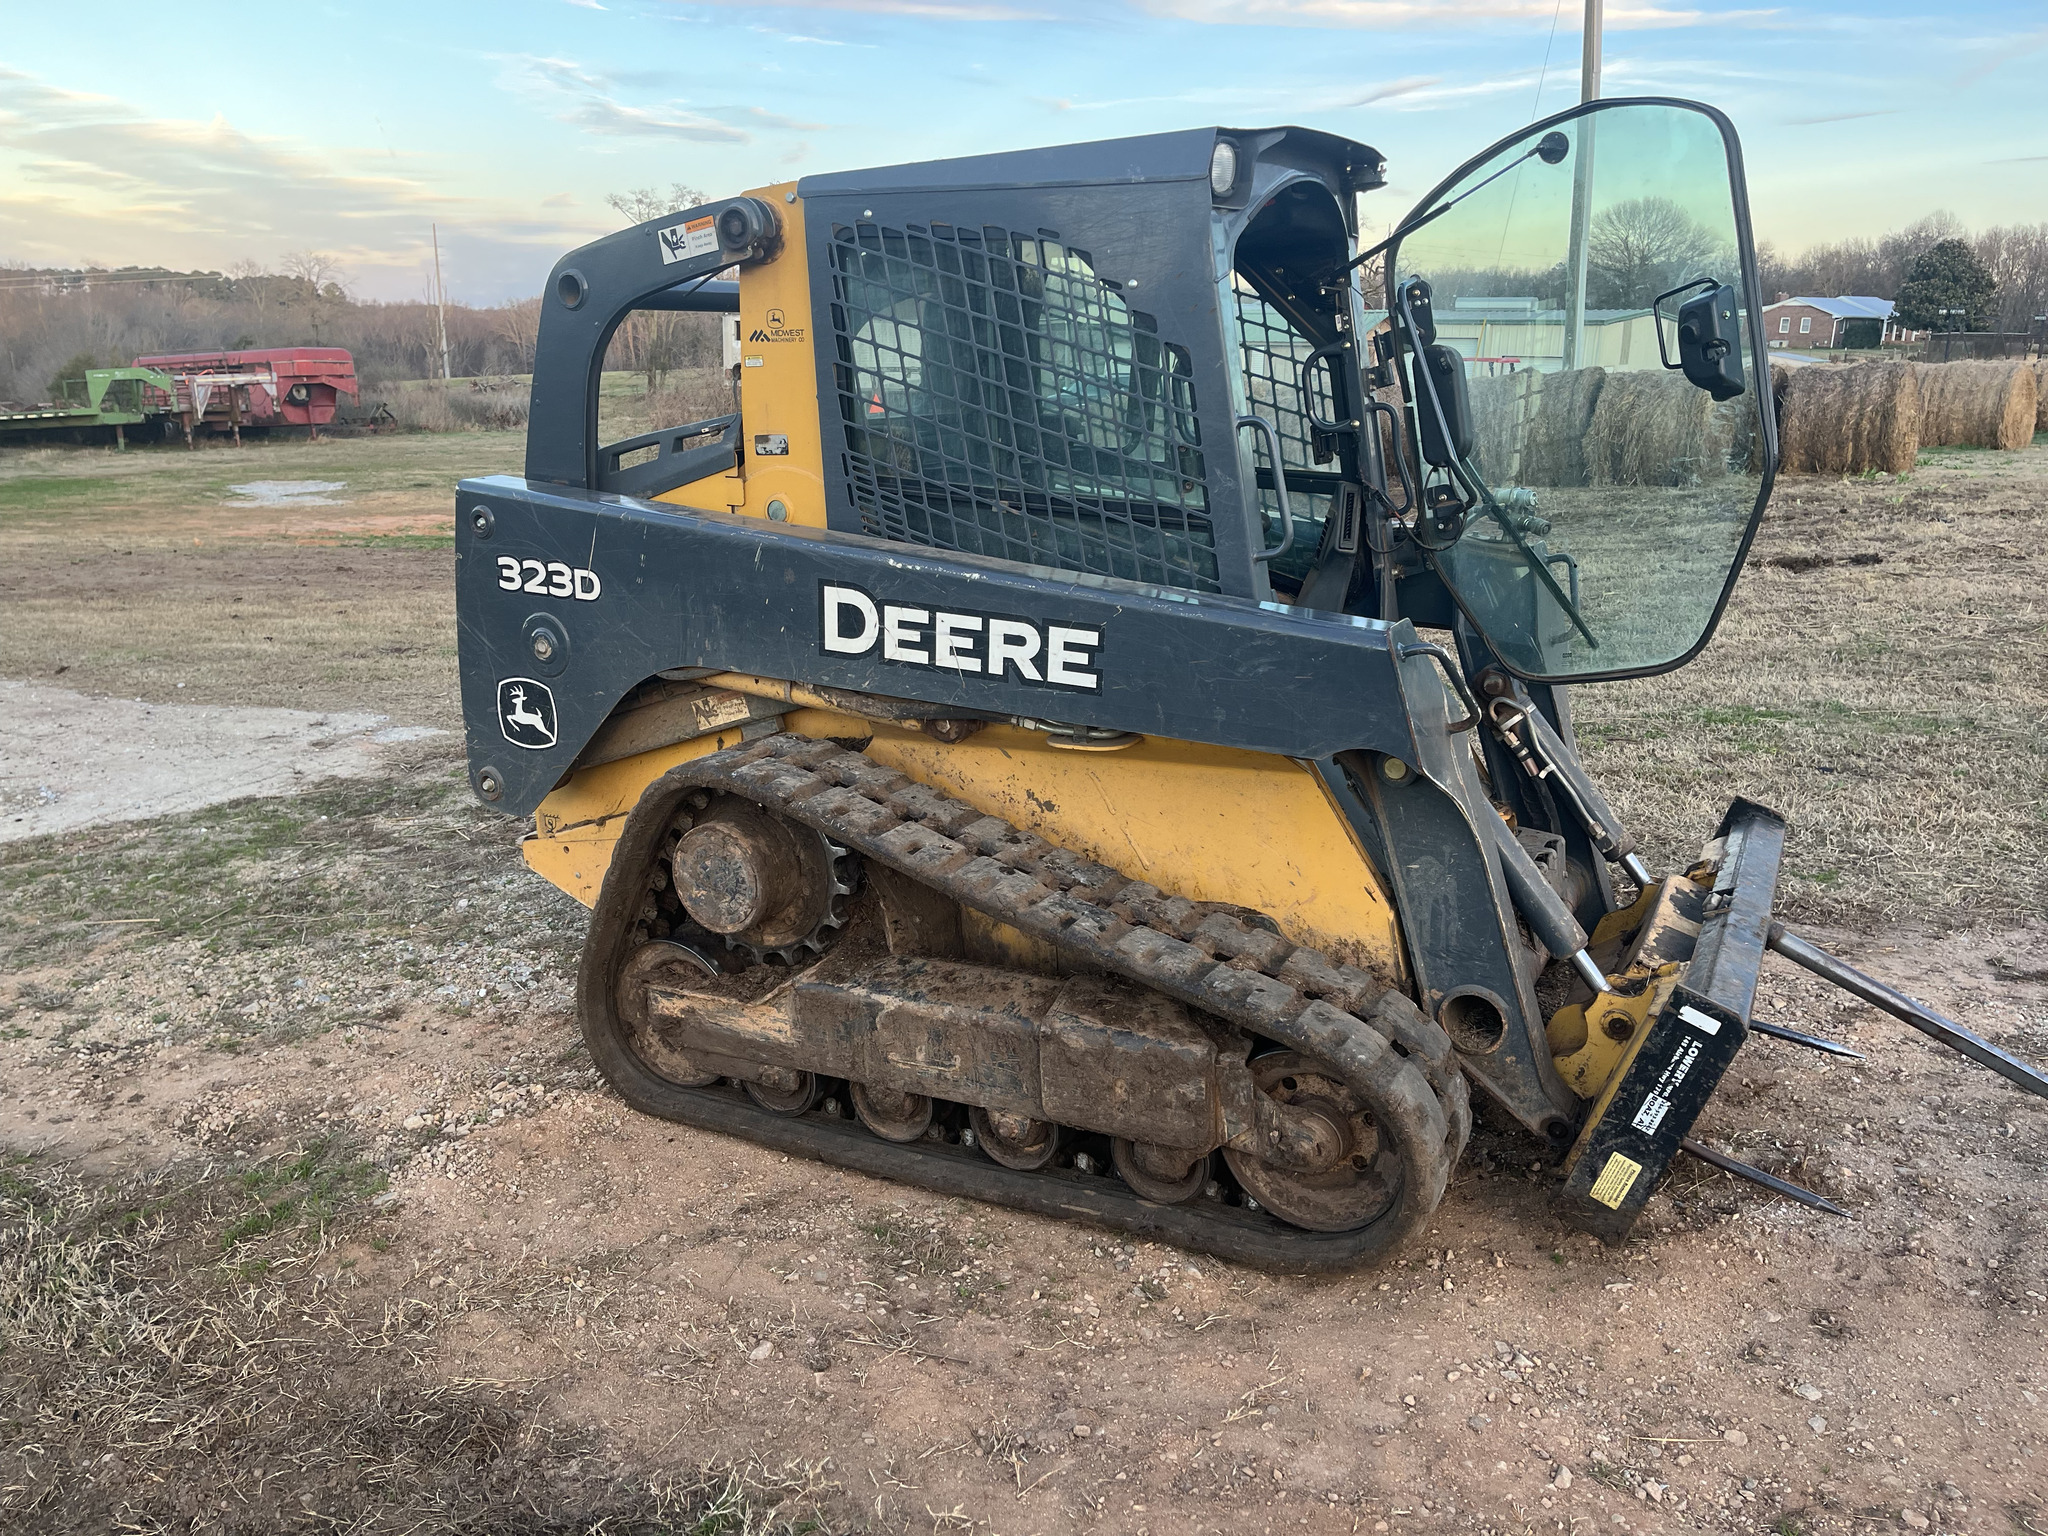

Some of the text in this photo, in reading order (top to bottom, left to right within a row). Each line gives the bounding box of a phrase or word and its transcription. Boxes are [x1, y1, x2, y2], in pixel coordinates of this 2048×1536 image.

[691, 219, 712, 229] WARNING
[770, 329, 805, 337] MIDWEST
[497, 556, 601, 601] 323D
[823, 585, 1099, 689] DEERE
[1658, 1070, 1671, 1084] Hwy
[1671, 1040, 1703, 1088] LOWERY
